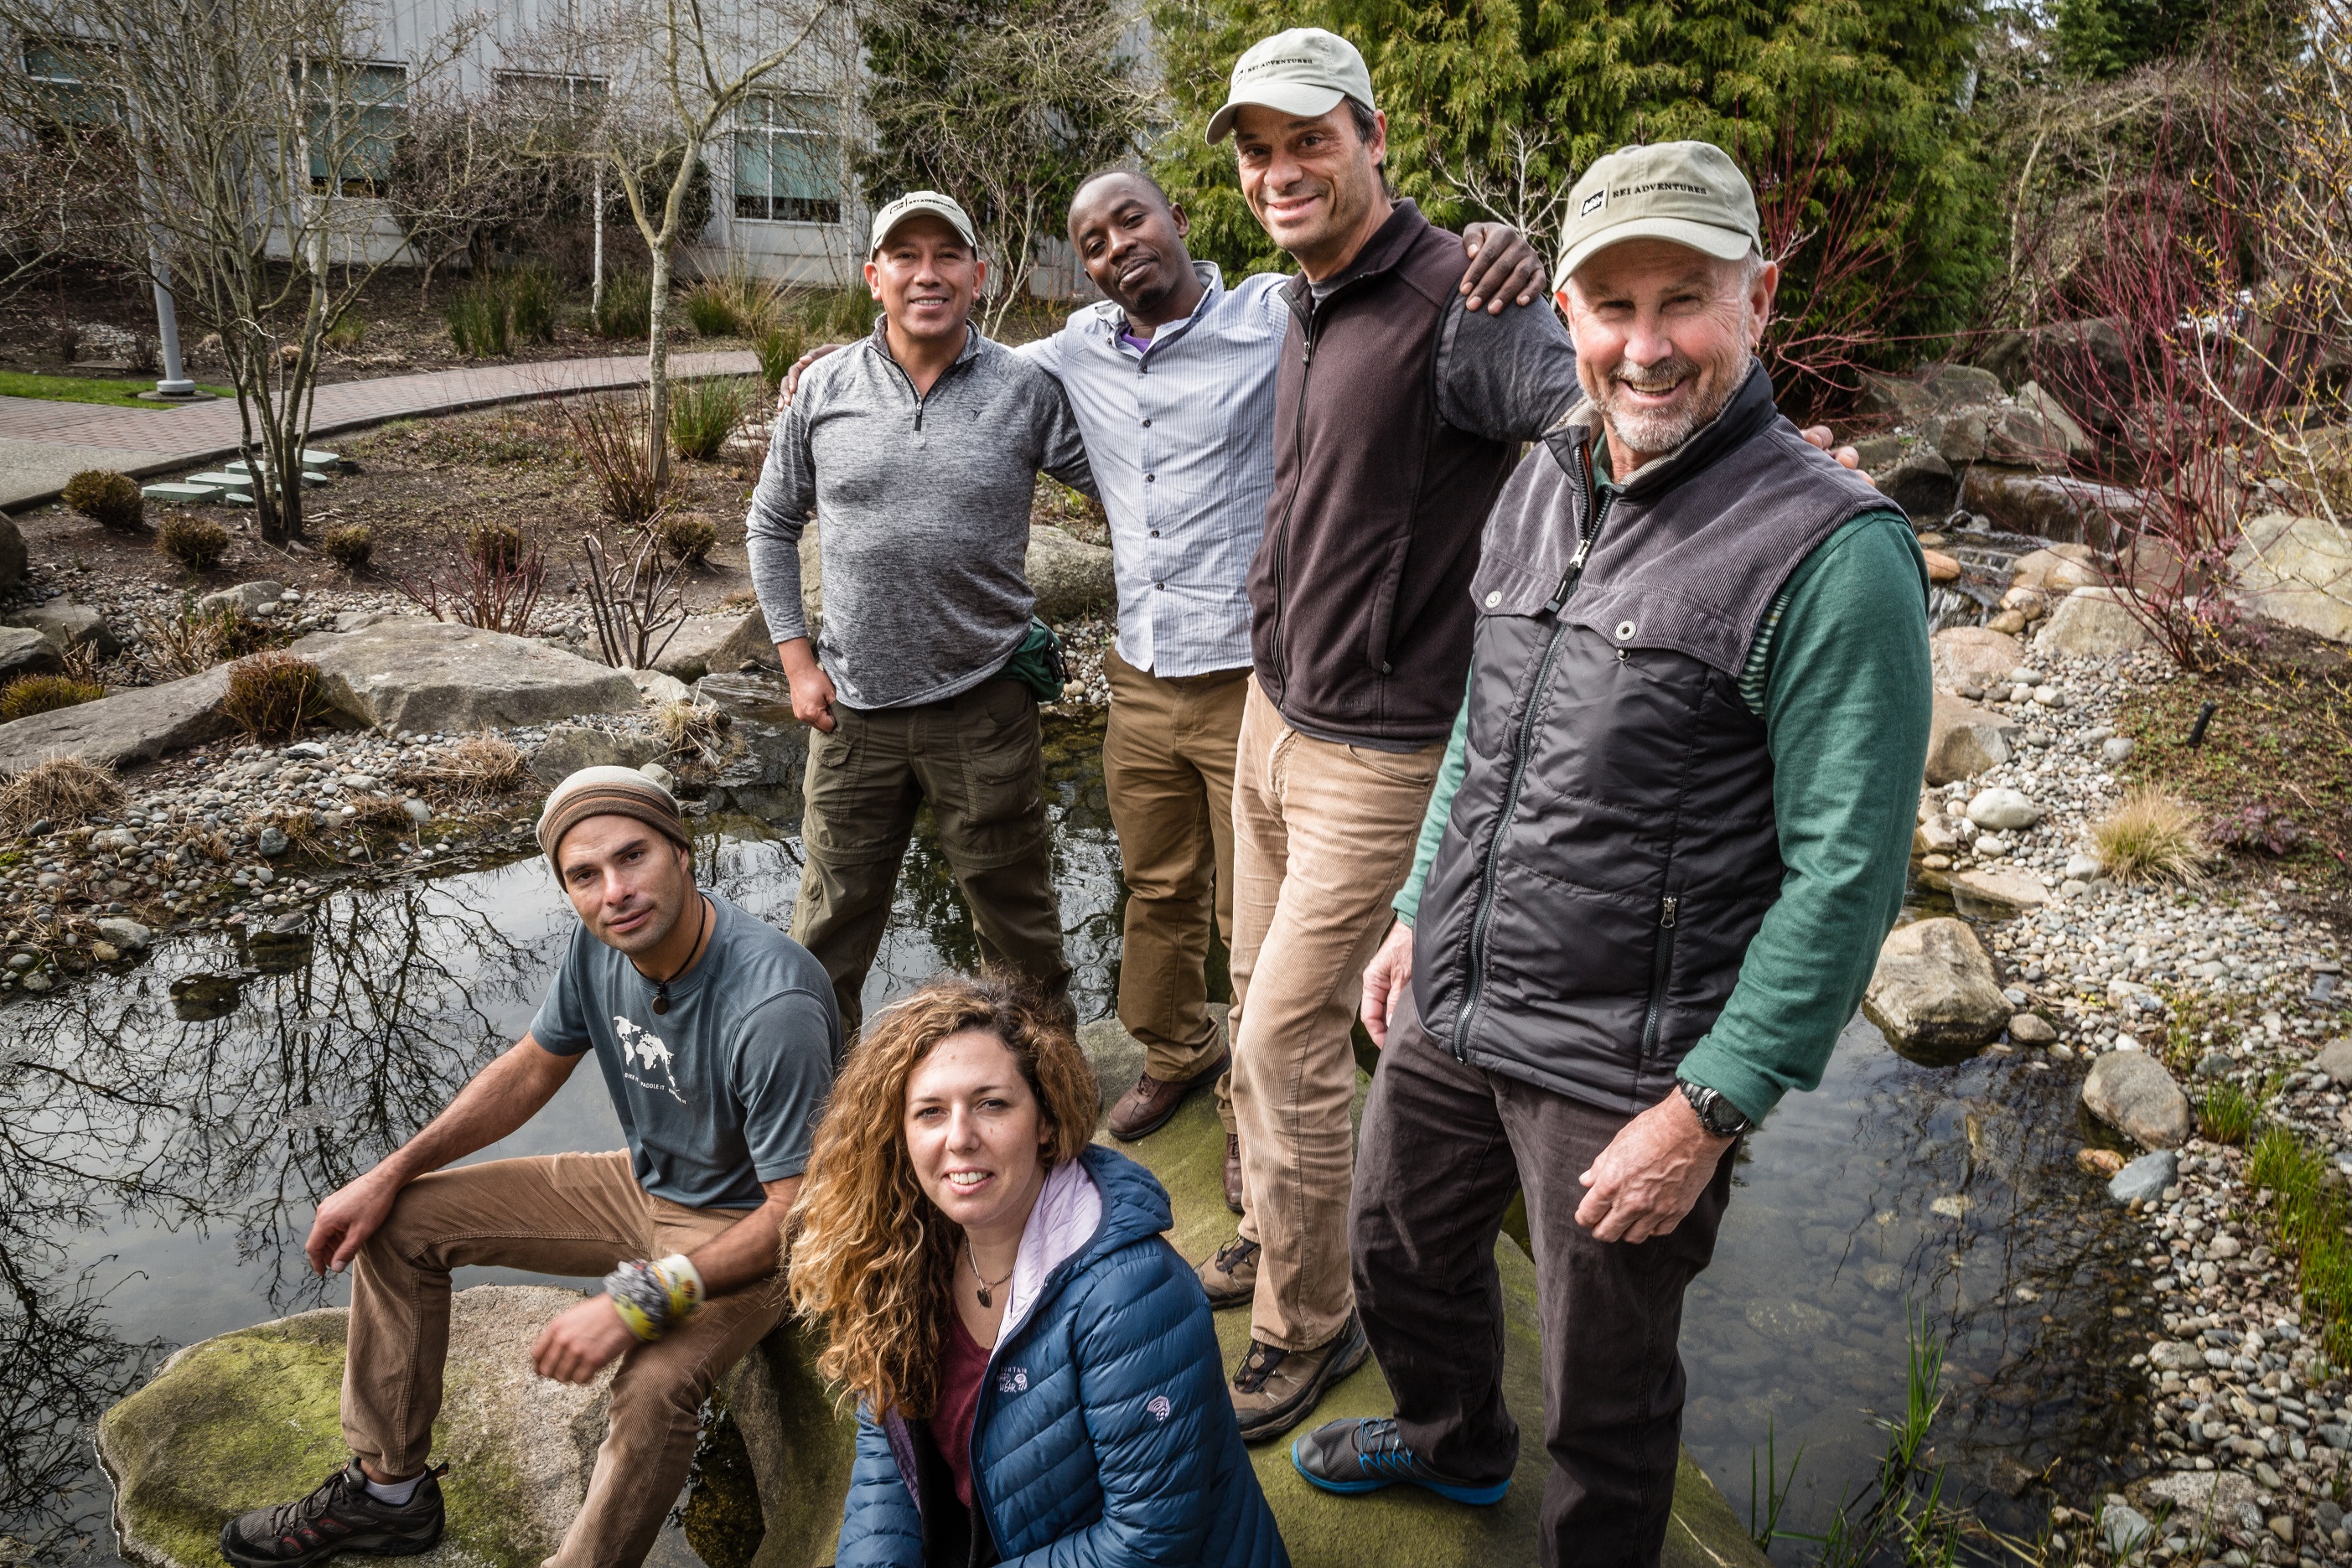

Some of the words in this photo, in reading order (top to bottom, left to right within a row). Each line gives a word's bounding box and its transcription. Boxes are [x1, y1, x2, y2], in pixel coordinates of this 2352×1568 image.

[1613, 188, 1631, 198] REI
[1634, 183, 1707, 194] ADVENTURES
[640, 1081, 660, 1089] PADDLE
[999, 1382, 1017, 1393] WEAR
